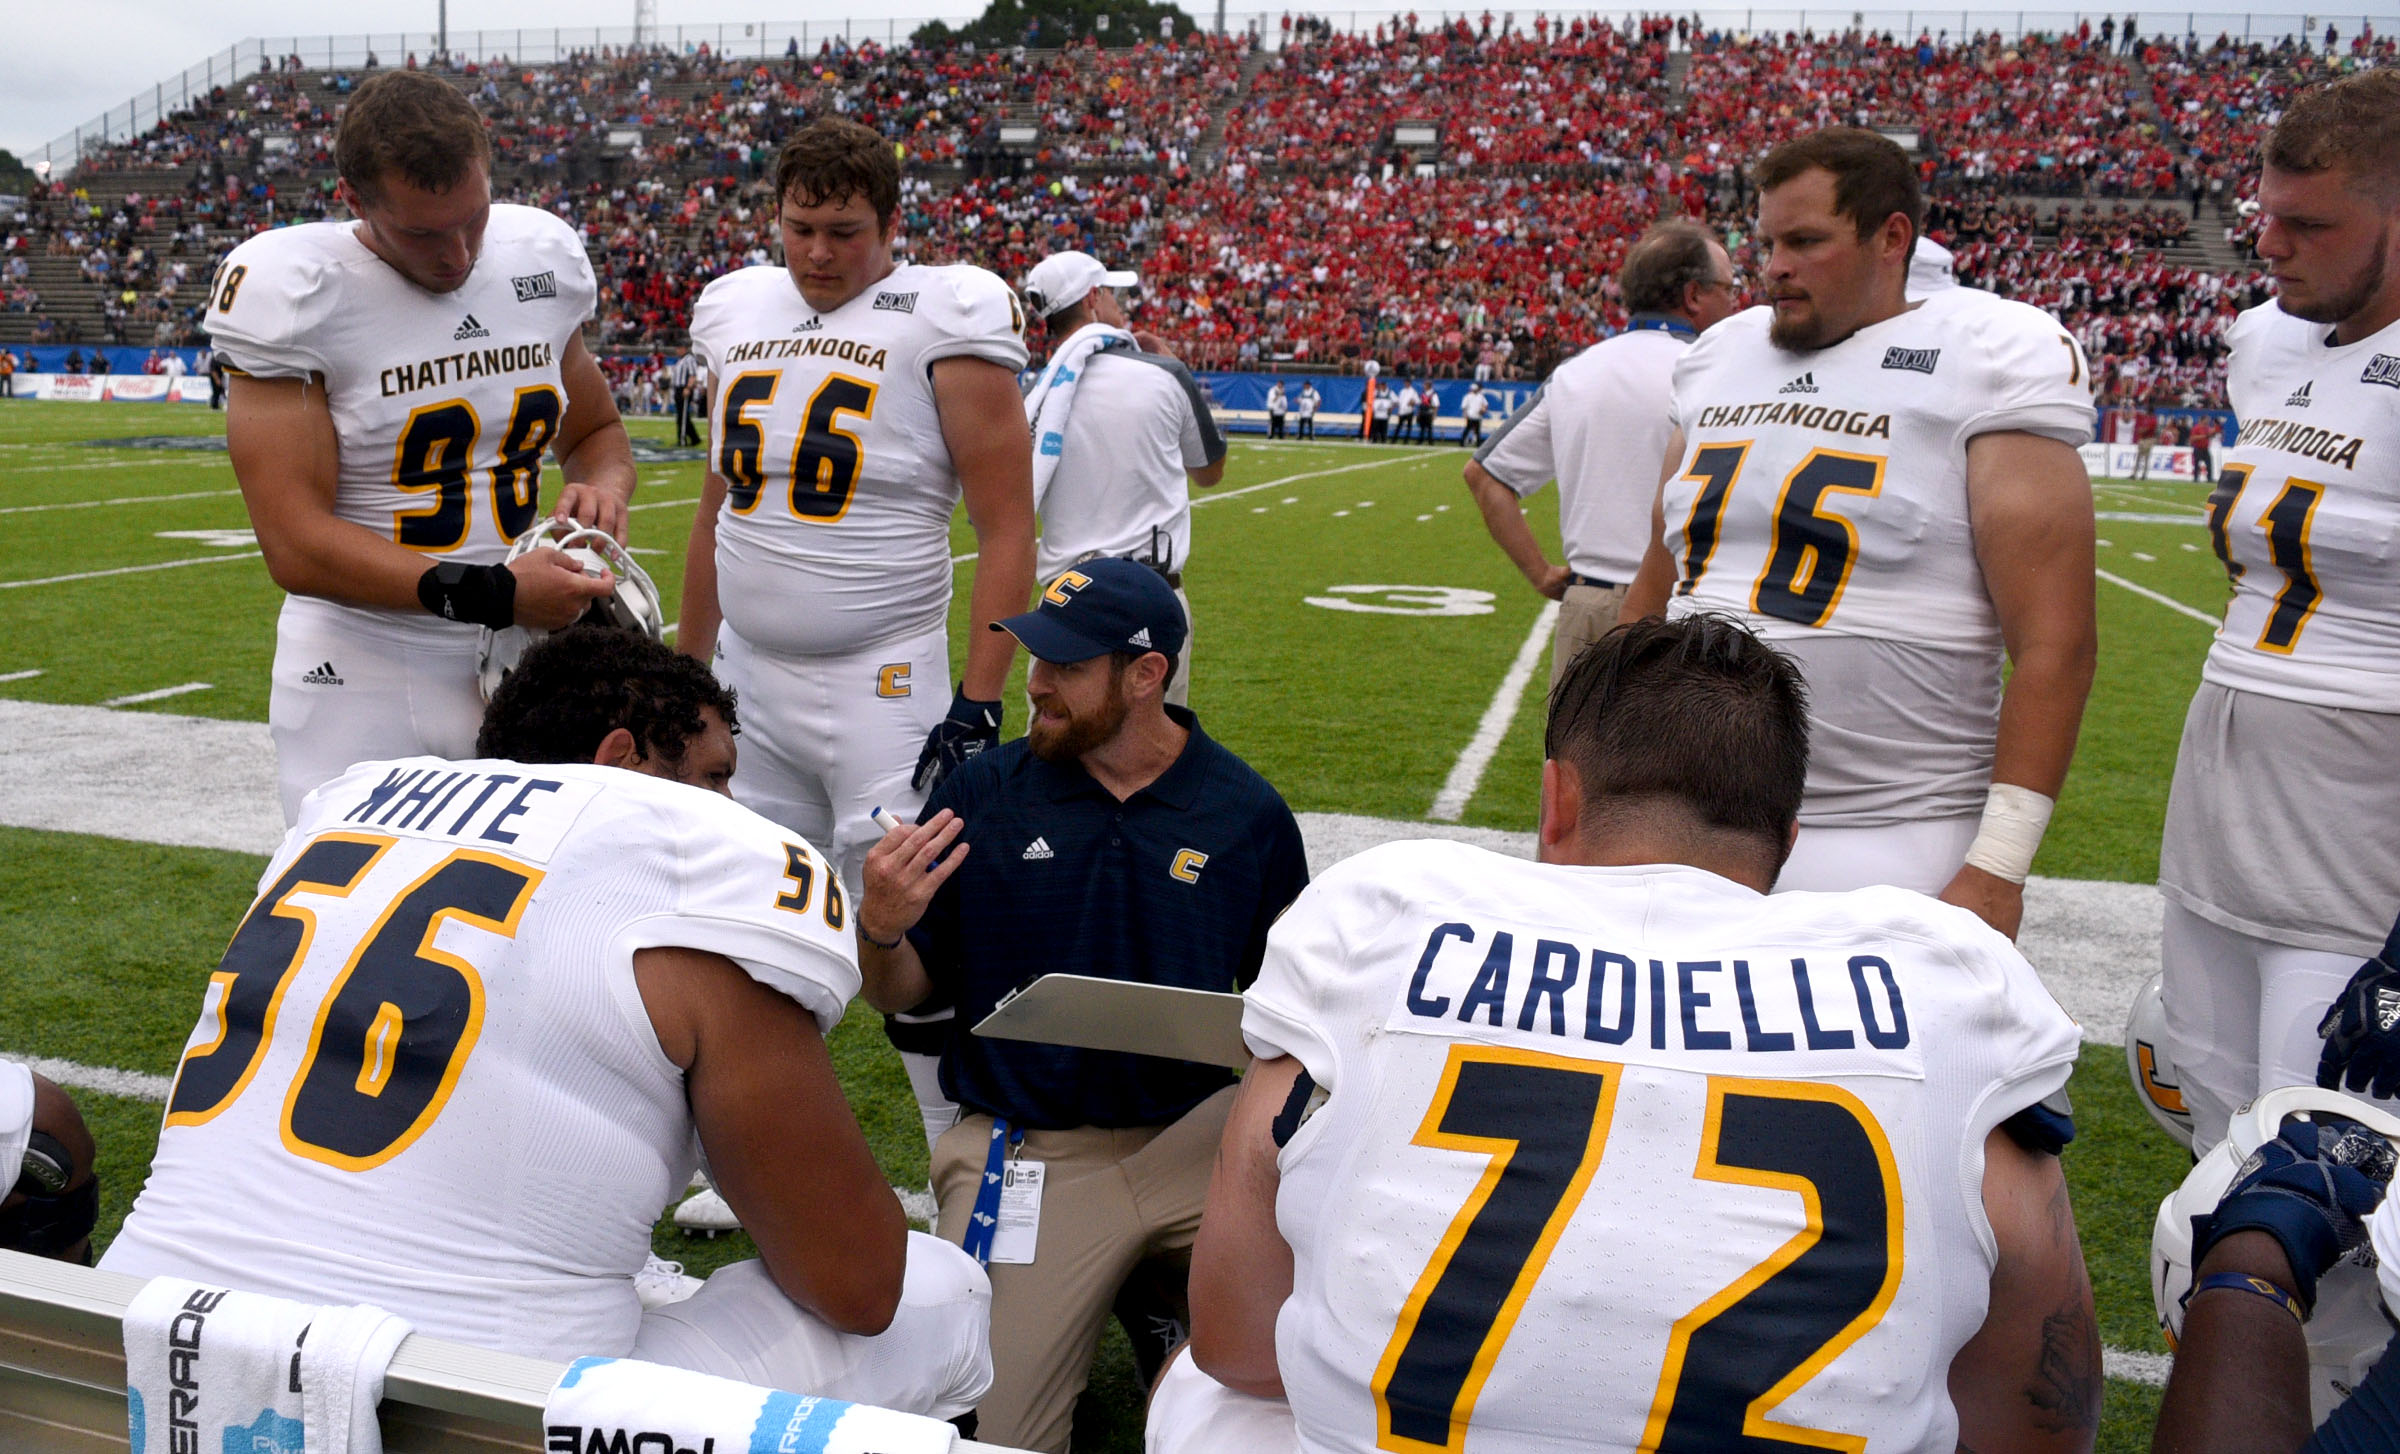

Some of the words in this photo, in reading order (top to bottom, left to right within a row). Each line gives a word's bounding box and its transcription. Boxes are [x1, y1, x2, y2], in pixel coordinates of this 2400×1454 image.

[513, 272, 556, 300] SOCON
[874, 292, 917, 313] SOCON
[453, 328, 490, 340] adidas
[380, 343, 552, 397] CHATTANOOGA
[725, 337, 888, 371] CHATTANOOGA
[1883, 347, 1938, 374] SOCON
[1779, 383, 1820, 394] adidas
[1697, 402, 1891, 440] CHATTANOOGA
[719, 369, 880, 523] 66
[392, 384, 564, 552] 98
[1677, 439, 1889, 629] 76
[2205, 462, 2325, 656] 71
[1128, 637, 1152, 649] adidas
[302, 674, 344, 686] adidas
[875, 661, 912, 699] C
[342, 767, 565, 845] WHITE
[1022, 850, 1055, 860] adidas
[773, 841, 845, 932] 56
[164, 830, 547, 1172] 56
[1406, 921, 1911, 1053] CARDIELLO
[1370, 1043, 1904, 1454] 72
